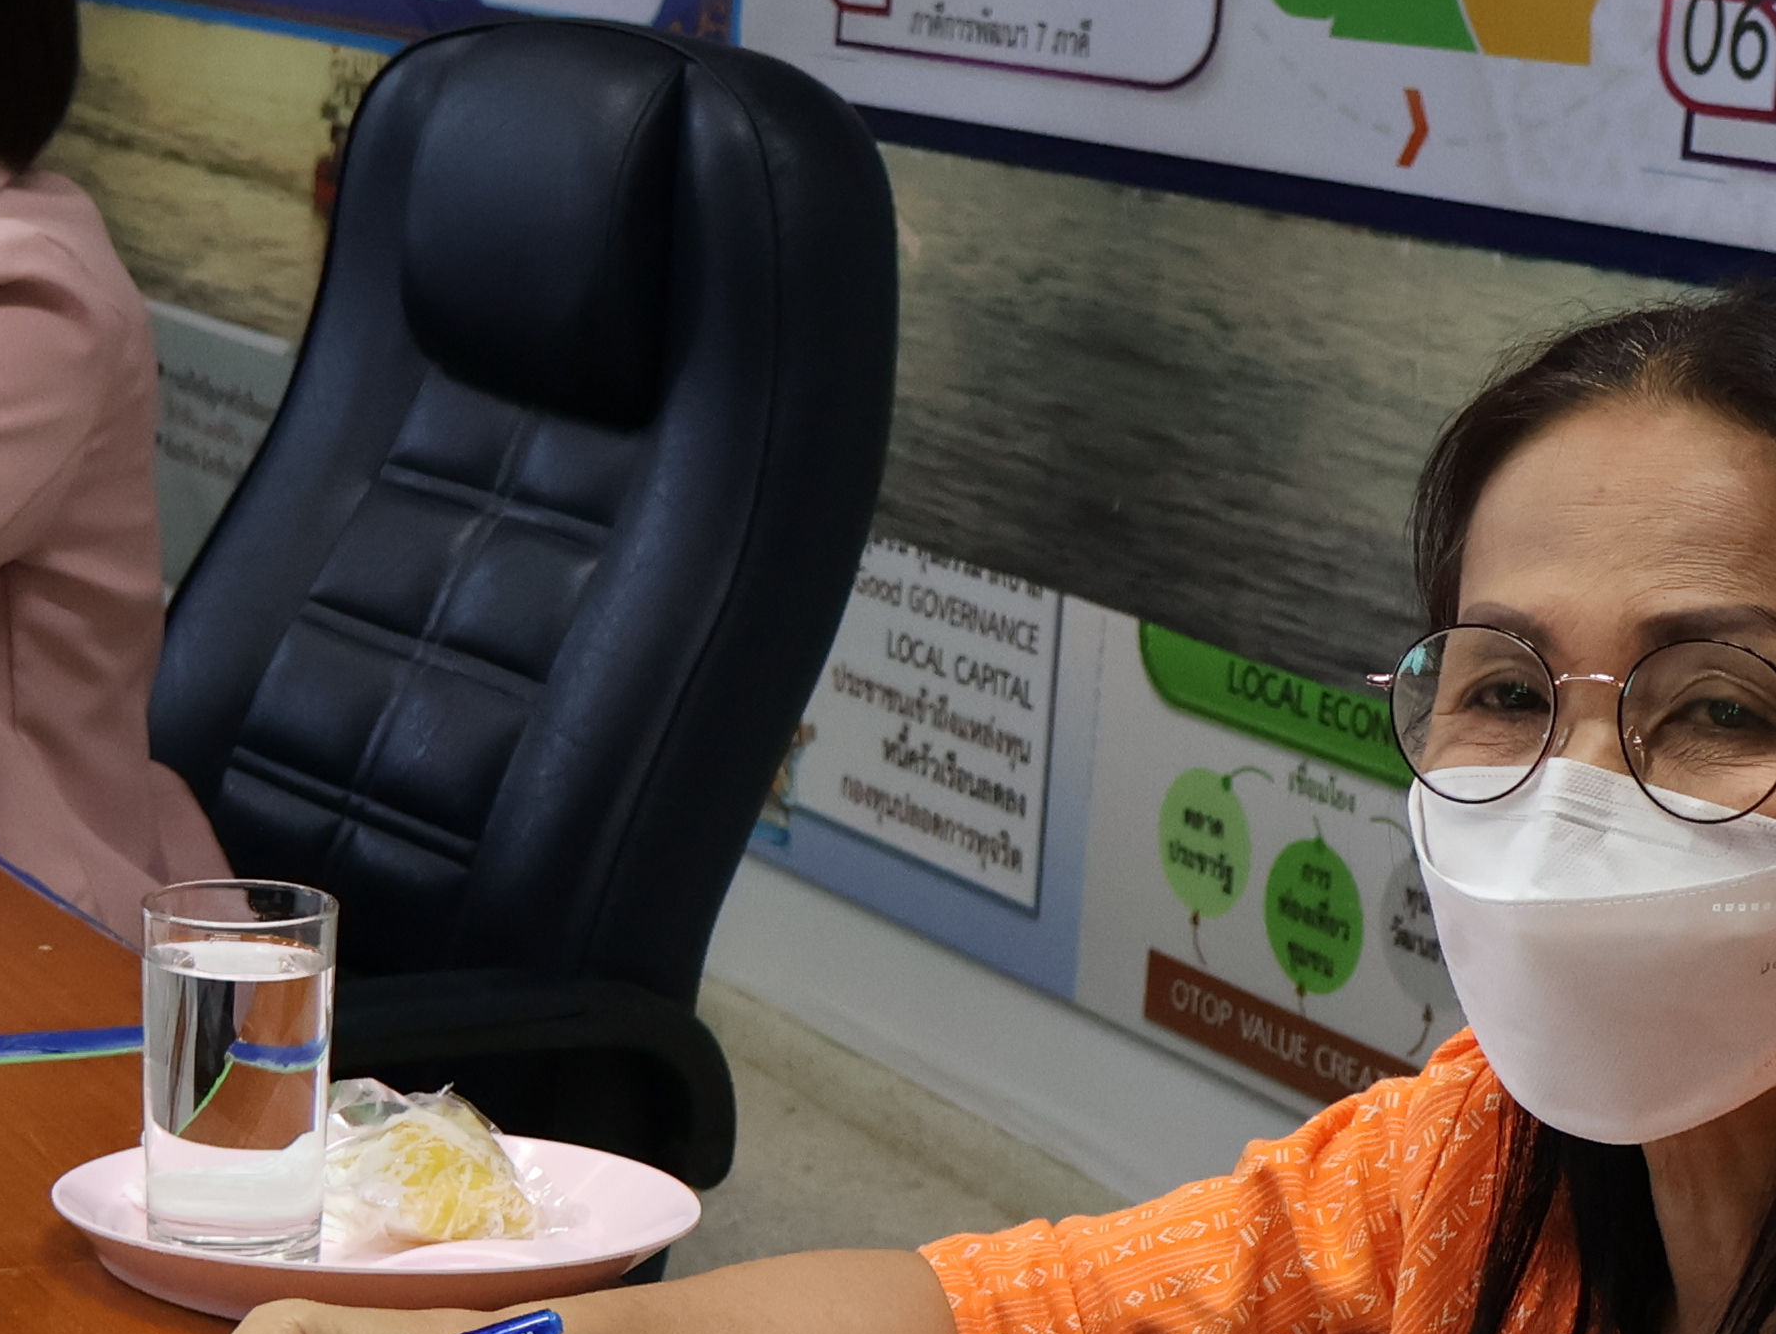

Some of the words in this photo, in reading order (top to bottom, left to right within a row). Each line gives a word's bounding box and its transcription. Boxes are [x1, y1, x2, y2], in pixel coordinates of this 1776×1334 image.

[909, 583, 1040, 655] GOVERNANCE
[886, 627, 947, 678] LOCAL
[954, 655, 1034, 711] CAPITAL
[1227, 660, 1308, 719] LOCAL
[1171, 978, 1234, 1028] OTOP
[1239, 1009, 1308, 1066] VALUE
